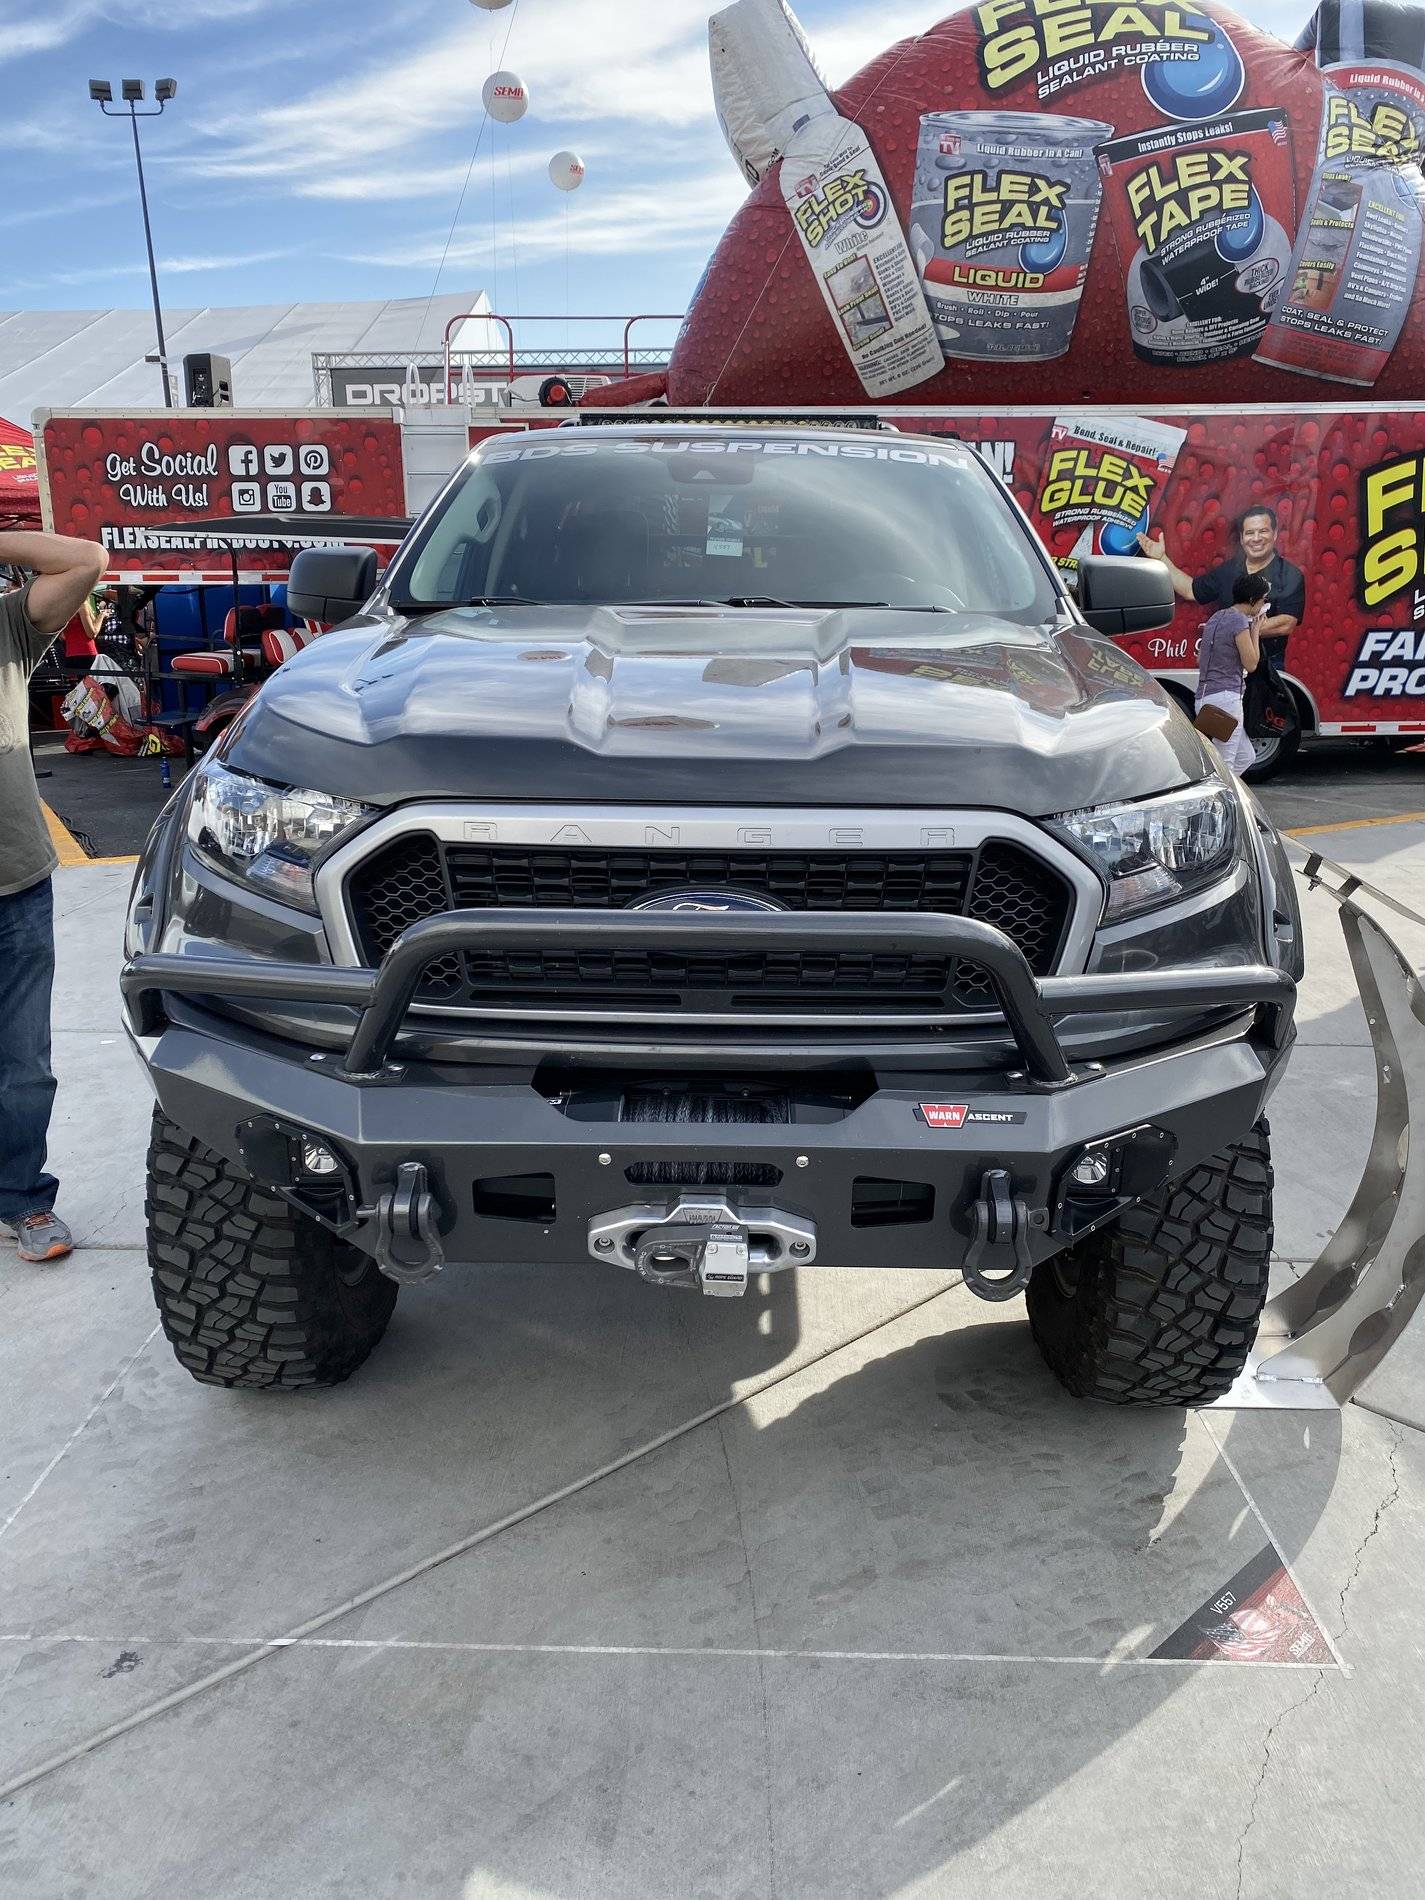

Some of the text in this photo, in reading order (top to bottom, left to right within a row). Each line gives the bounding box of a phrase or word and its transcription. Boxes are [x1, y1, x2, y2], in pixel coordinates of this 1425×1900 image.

[983, 6, 1209, 89] SEAL
[1036, 41, 1199, 85] LIQUID RUBBER
[1037, 52, 1200, 100] SEALANT COATING
[1138, 122, 1233, 153] Instantly Stops Leaks!
[977, 143, 1006, 156] Liquid
[1007, 145, 1043, 158] Rubber
[1064, 149, 1083, 159] Can!
[946, 172, 1068, 212] FLEX
[1127, 152, 1249, 220] FLEX
[795, 169, 868, 231] FLEX
[805, 185, 869, 247] SHOT
[943, 202, 1060, 248] SEAL
[1137, 183, 1249, 252] TAPE
[965, 236, 1050, 258] SEALANT COATING
[966, 230, 1051, 250] LIQUID RUBBER
[1161, 220, 1249, 265] WATERPROOF TAPE
[1161, 230, 1193, 256] STRONG
[953, 265, 1046, 289] LIQUID
[1196, 280, 1220, 296] WIDE!
[967, 291, 1019, 306] WHITE
[932, 313, 1050, 330] TOPS LEAKS FAST!
[968, 307, 984, 316] Roll
[995, 309, 1010, 318] Dip
[1281, 305, 1389, 337] COAT, SEAL & PROTECT
[1280, 315, 1383, 346] STOPS LEAKS FAST!
[345, 381, 508, 405] DROPST
[482, 441, 968, 470] BDS SUSPENSION
[1098, 433, 1117, 445] Seal
[1125, 440, 1156, 457] Repair!
[106, 442, 219, 481] Get Social
[1049, 450, 1155, 498] FLEX
[120, 483, 209, 507] With Us!
[274, 484, 288, 494] You
[1041, 479, 1148, 519] GLUE
[272, 496, 291, 508] Tube
[1054, 507, 1090, 520] STRONG
[1052, 515, 1101, 527] WATERPROOF
[1056, 557, 1079, 569] STR
[1148, 638, 1188, 658] Phil
[463, 821, 956, 847] RANGER
[928, 1110, 1014, 1122] WARN ASCENT
[1210, 1591, 1237, 1614] V557
